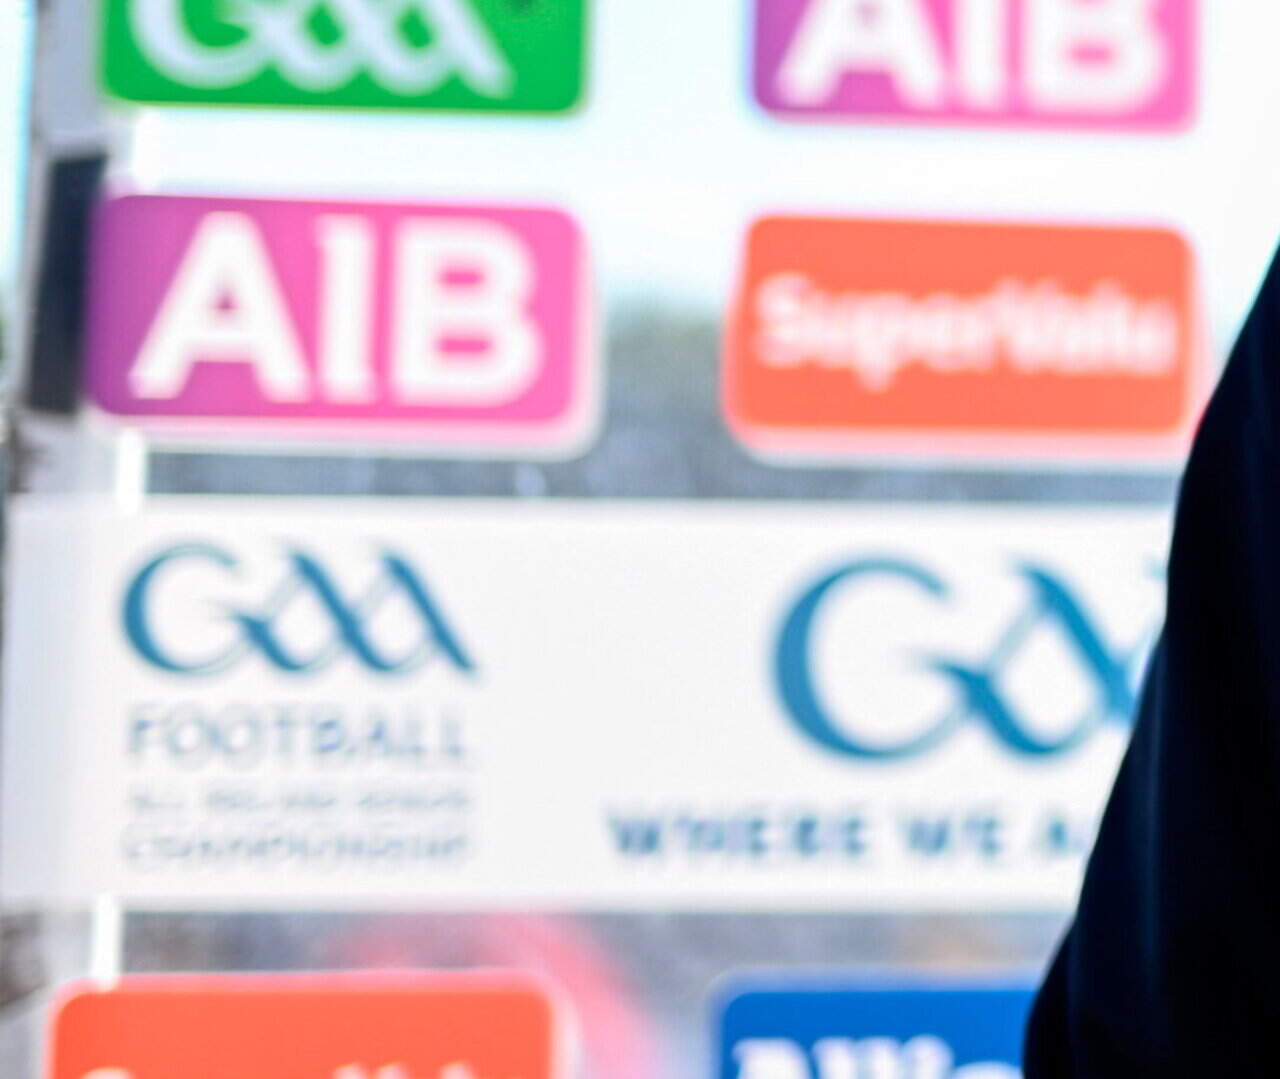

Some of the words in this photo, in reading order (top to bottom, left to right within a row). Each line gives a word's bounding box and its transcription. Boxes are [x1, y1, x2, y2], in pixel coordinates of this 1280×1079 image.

[130, 210, 546, 402] AIB
[120, 538, 478, 680] GAA
[770, 554, 1168, 764] GA
[126, 704, 472, 768] FOOTBALL
[608, 802, 872, 864] WHERE
[902, 804, 1010, 864] WE
